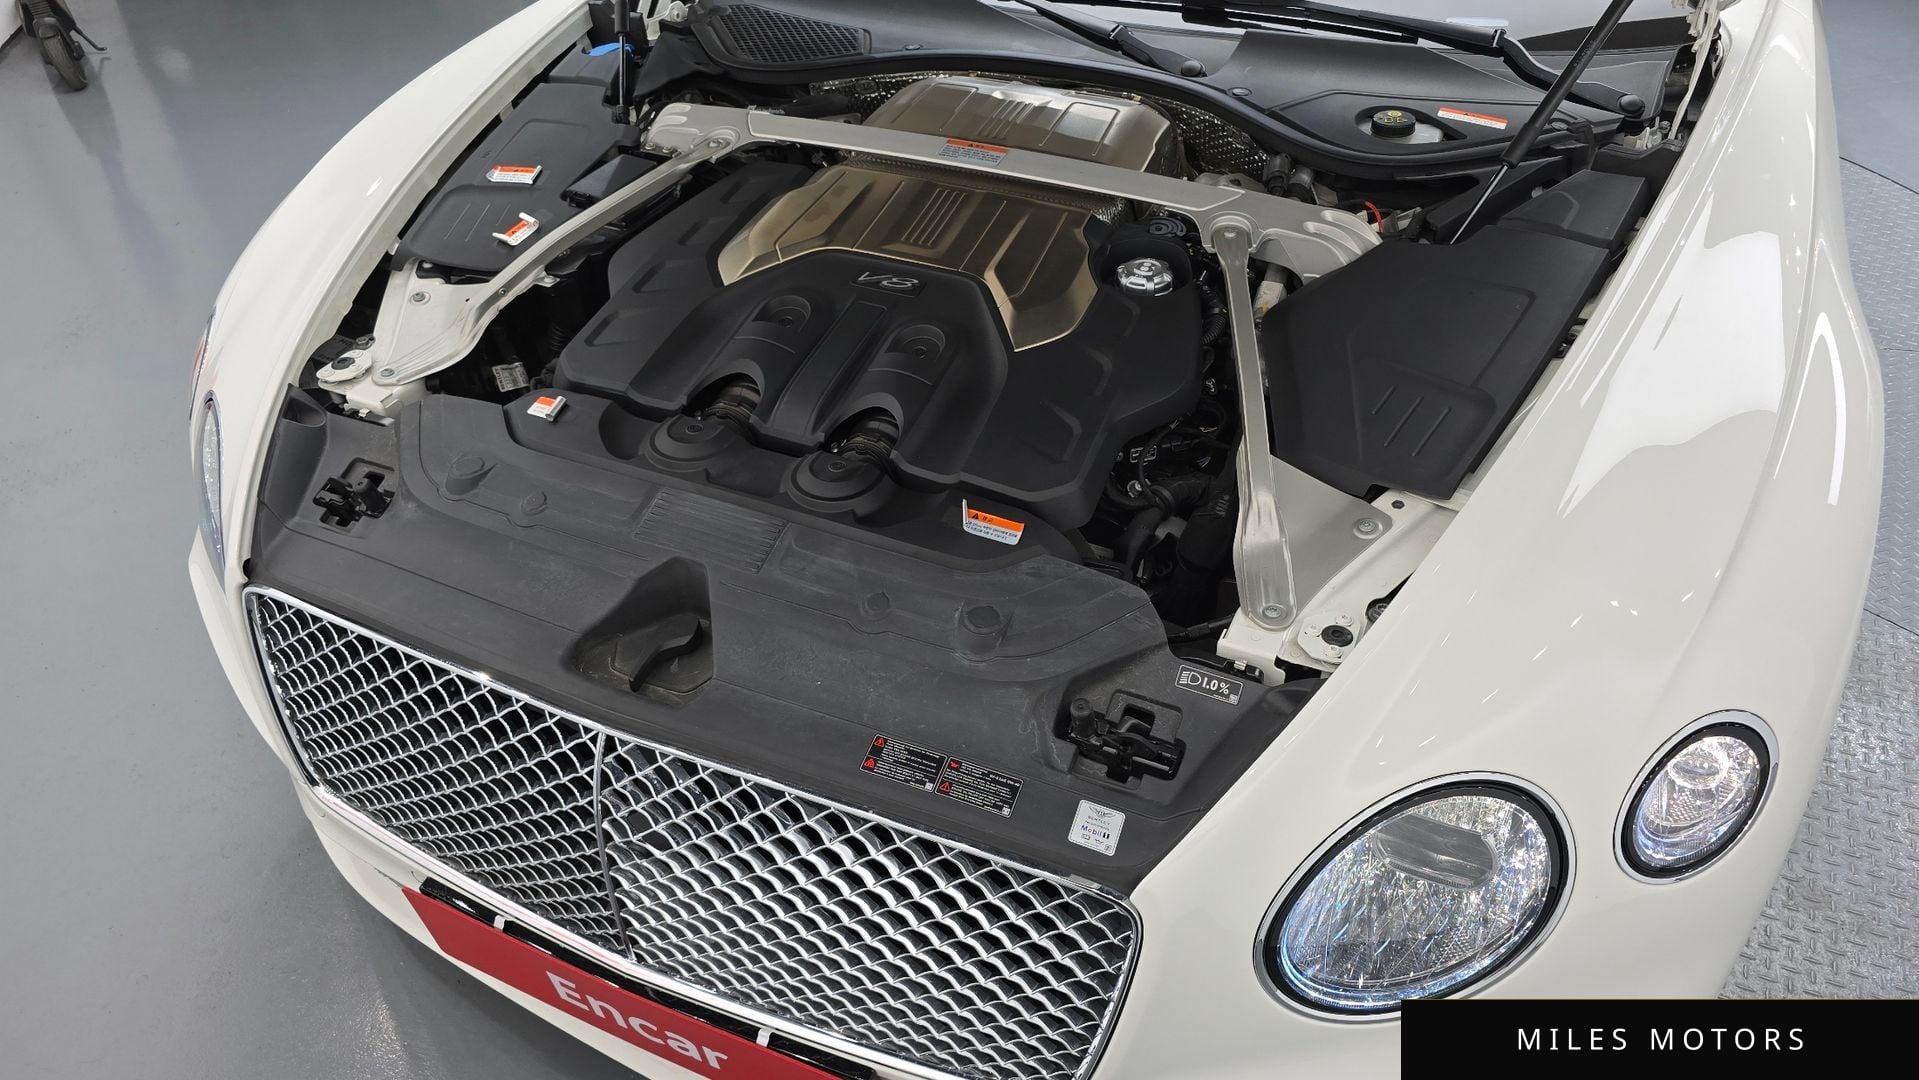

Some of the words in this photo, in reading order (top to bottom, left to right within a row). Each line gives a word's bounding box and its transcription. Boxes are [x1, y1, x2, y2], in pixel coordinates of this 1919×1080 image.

[857, 271, 919, 288] V8
[1202, 677, 1230, 694] 1.0%
[1080, 824, 1103, 837] Mobil
[546, 970, 728, 1069] Encar
